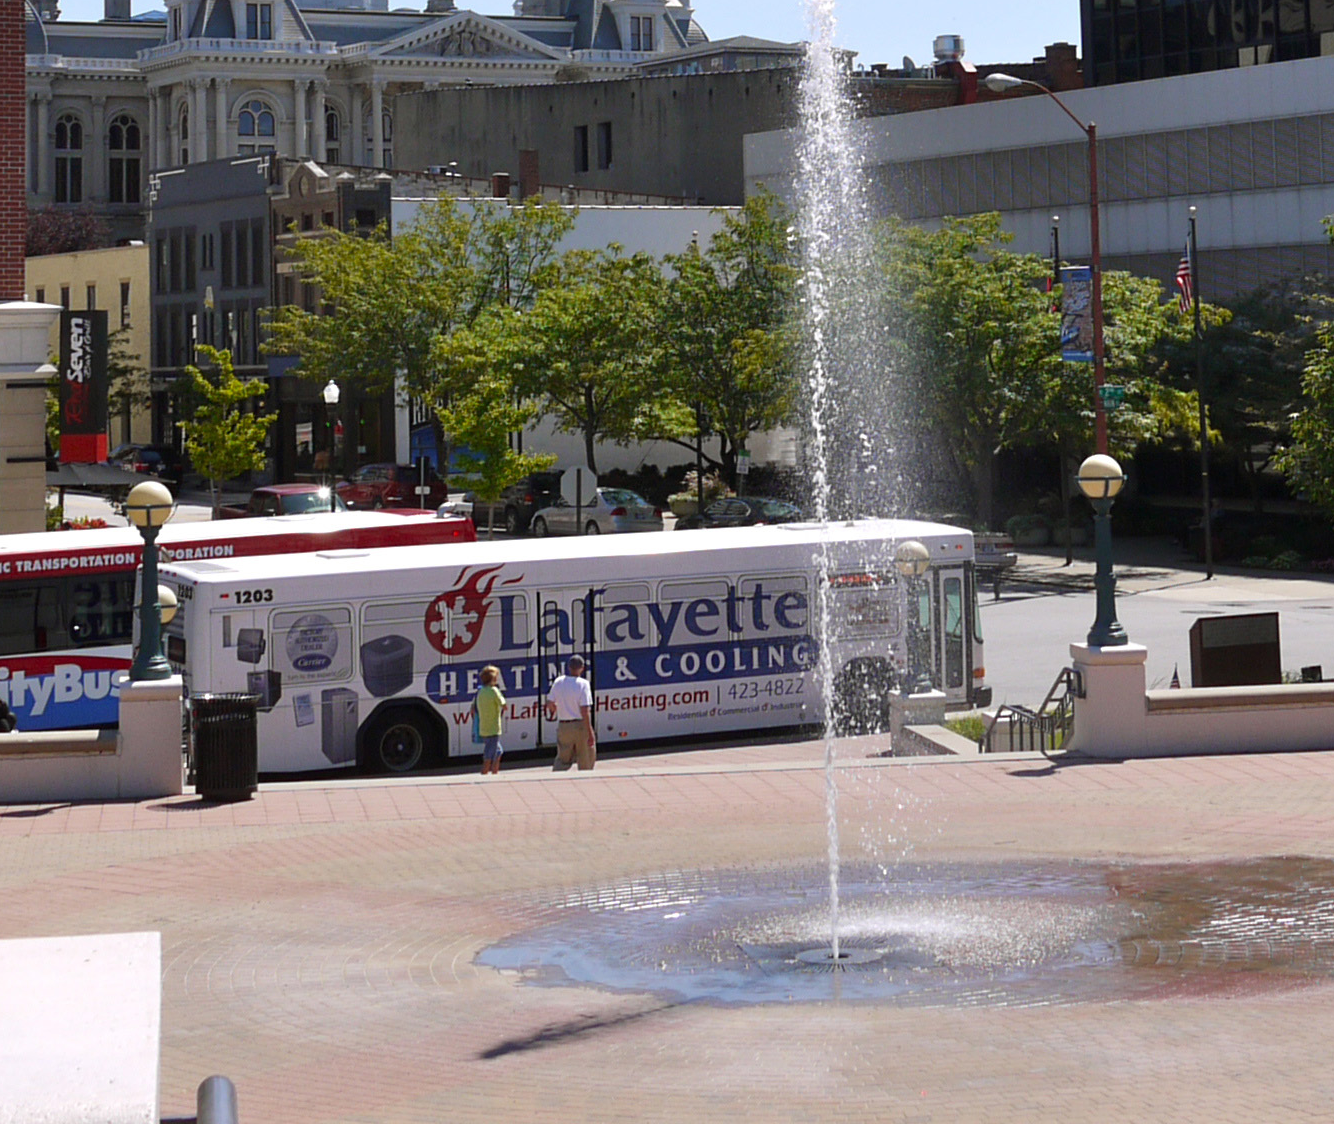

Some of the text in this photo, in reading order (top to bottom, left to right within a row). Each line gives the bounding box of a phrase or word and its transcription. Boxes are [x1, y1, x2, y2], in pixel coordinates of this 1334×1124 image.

[67, 317, 83, 383] Seven
[16, 553, 135, 572] TRANSPORTATION
[140, 545, 234, 562] PORATION
[235, 589, 273, 604] 1203
[499, 583, 808, 654] Lafayette
[298, 658, 326, 666] Carrier
[615, 656, 637, 681] &
[655, 641, 809, 677] COOLING
[727, 678, 805, 700] 423-4822
[668, 708, 708, 720] Residential
[717, 704, 759, 716] Commercial
